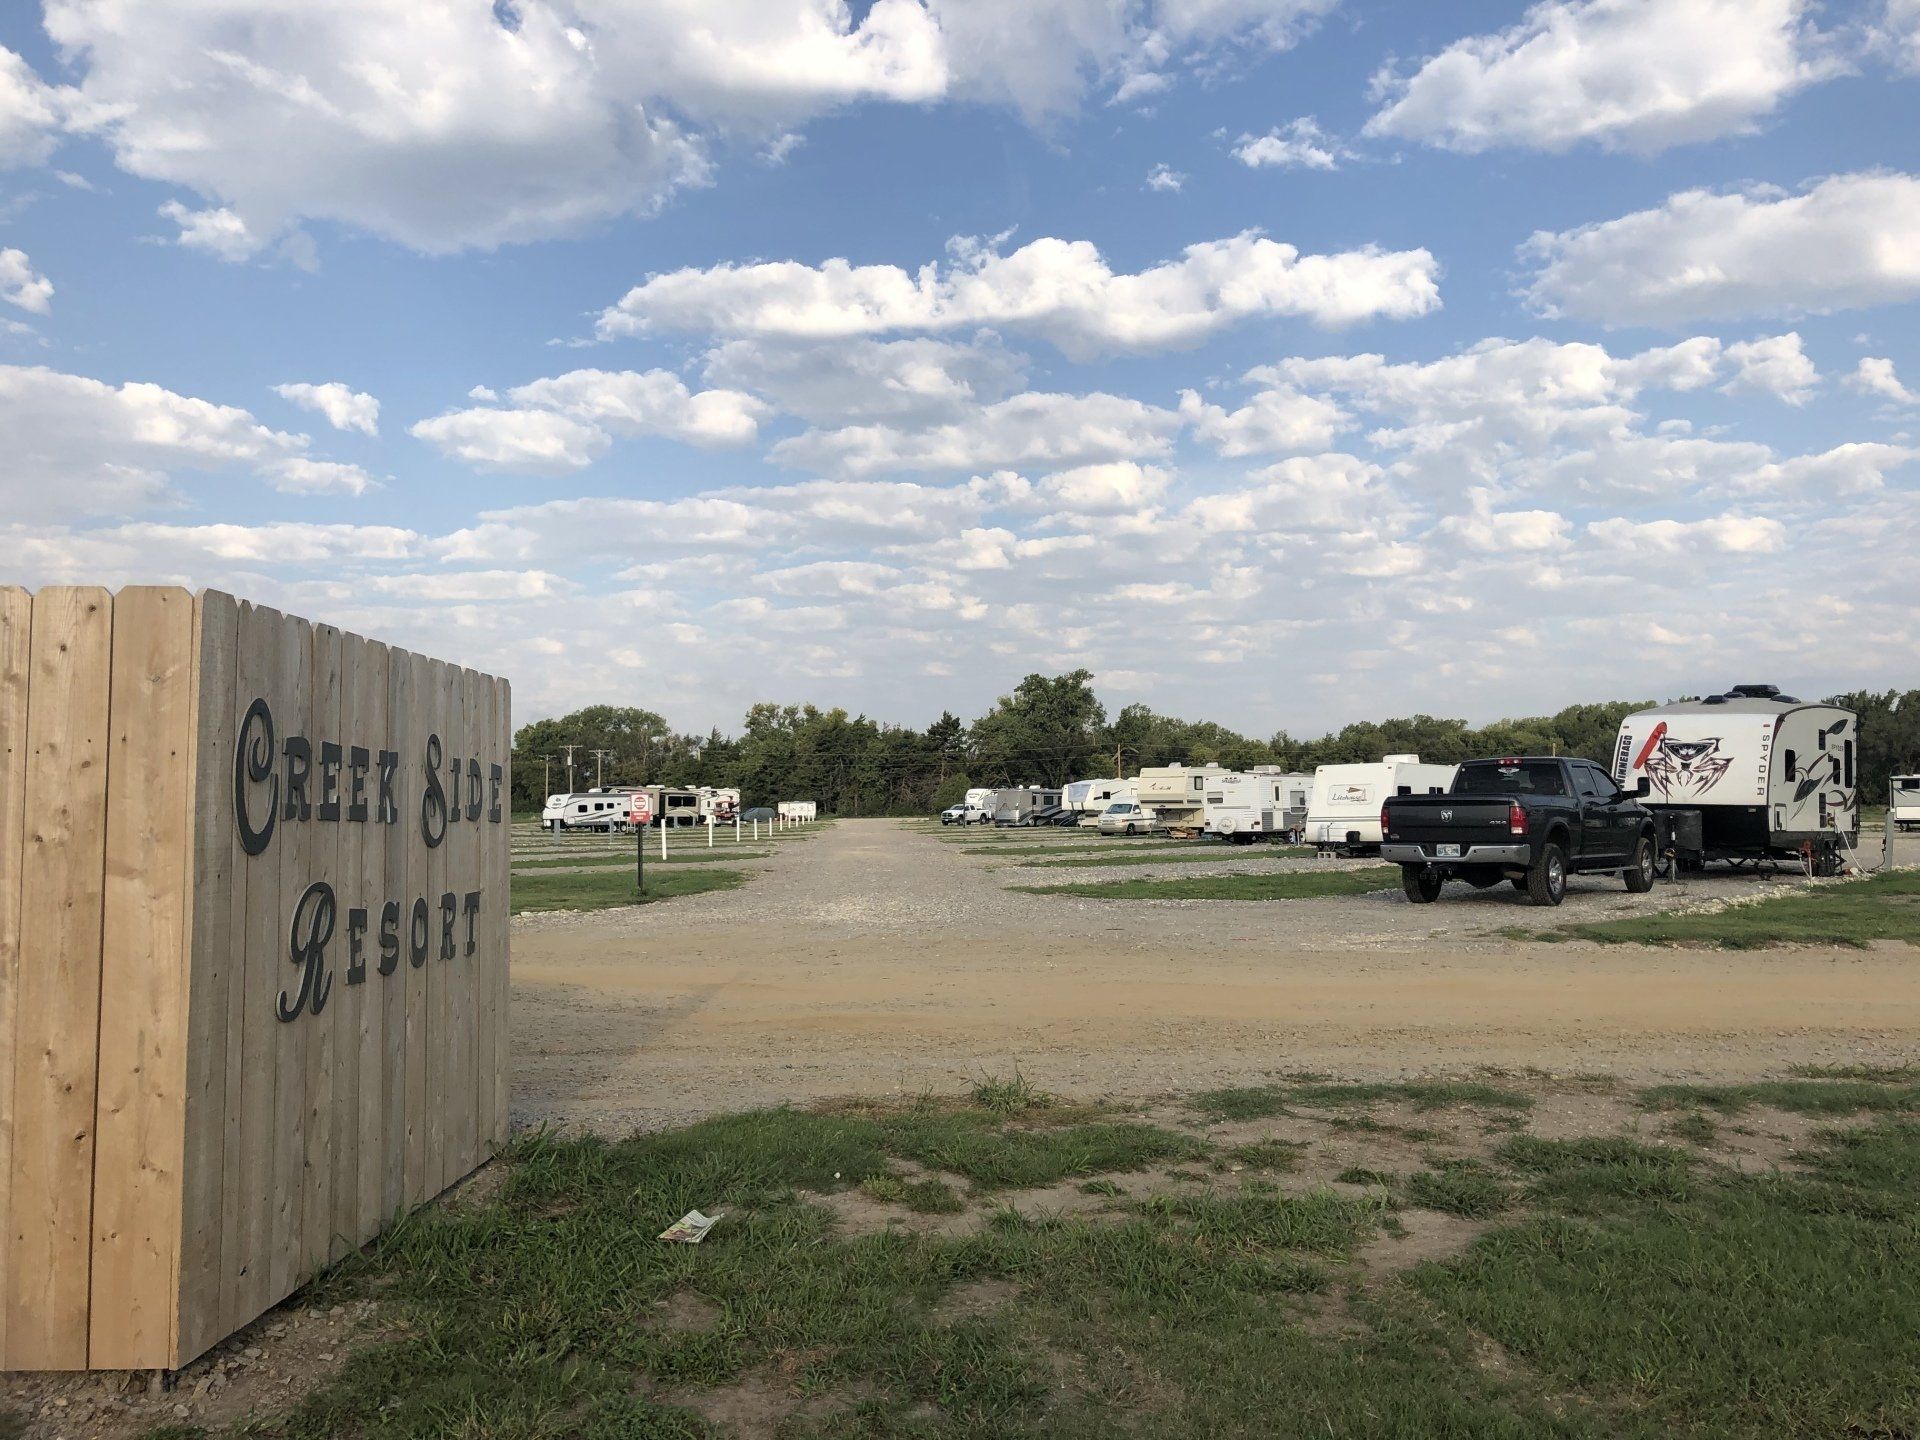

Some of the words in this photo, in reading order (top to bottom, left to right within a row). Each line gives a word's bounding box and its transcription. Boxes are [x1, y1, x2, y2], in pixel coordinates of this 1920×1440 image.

[233, 698, 399, 856] CREEK
[421, 733, 503, 848] SIDE
[1756, 734, 1771, 796] SPYDER
[275, 881, 481, 1023] RESORT
